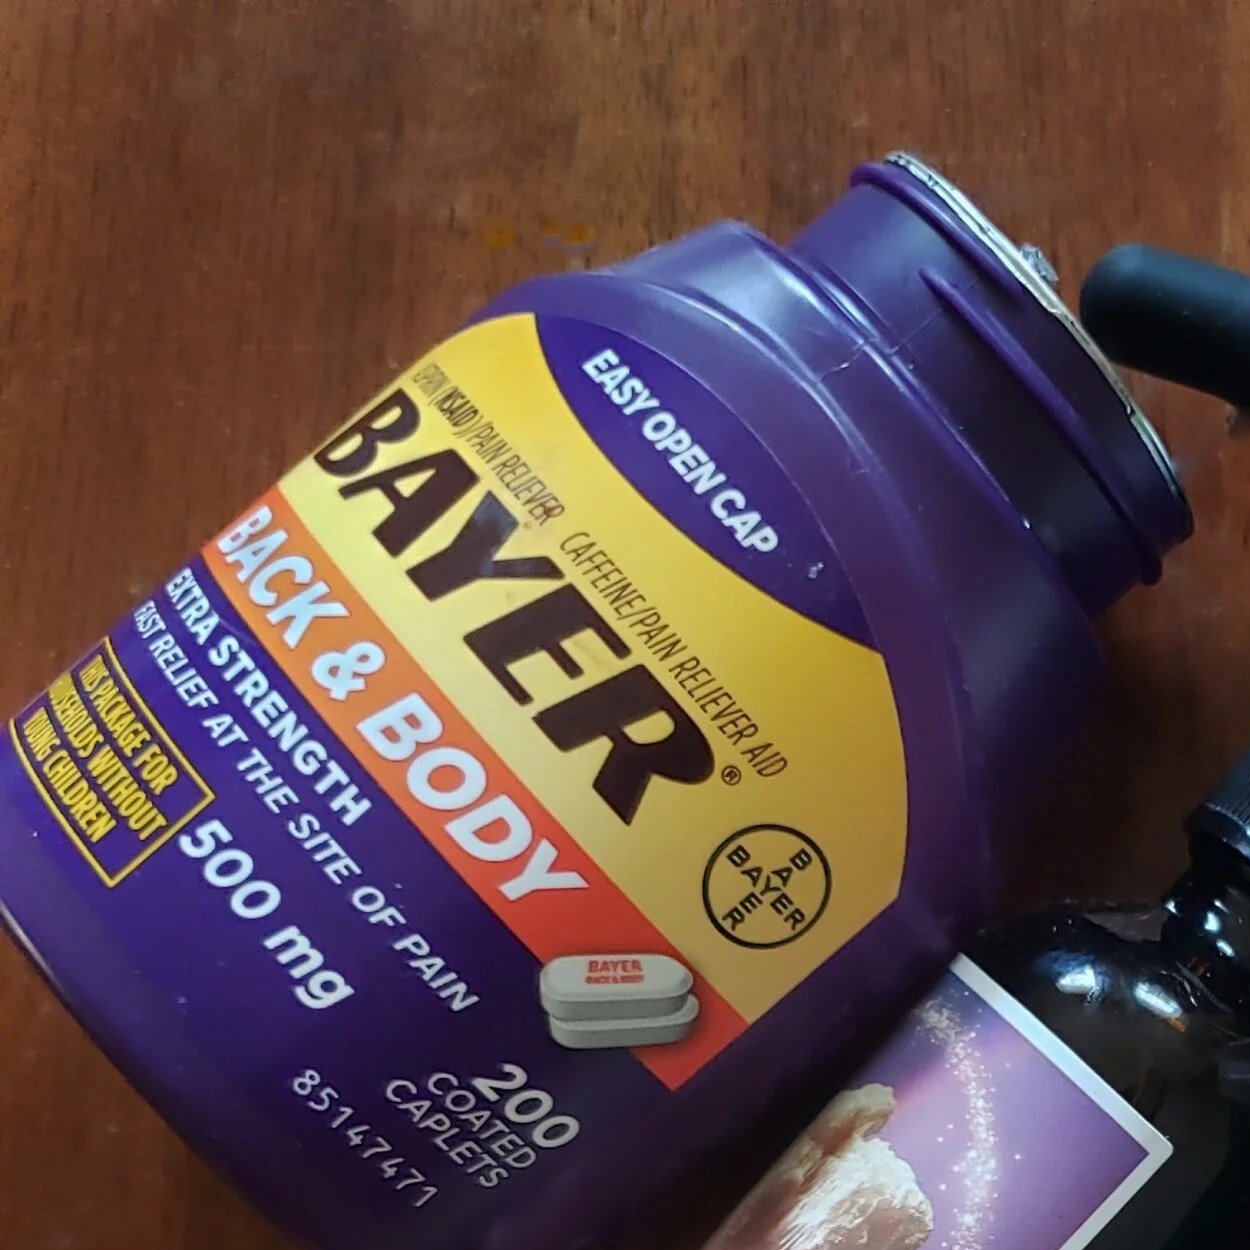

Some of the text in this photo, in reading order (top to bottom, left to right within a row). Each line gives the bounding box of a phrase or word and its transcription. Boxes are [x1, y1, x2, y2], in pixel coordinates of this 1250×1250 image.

[491, 453, 565, 526] RELIEVER
[582, 348, 779, 553] EASY OPEN CAP
[314, 387, 714, 827] BAYER
[560, 531, 788, 778] CAFFEINE/PAIN RELIEVER AID
[48, 672, 168, 841] SEHOLDS WITHOUT
[89, 677, 152, 758] PACKAGE
[133, 743, 178, 795] FOR
[165, 567, 372, 826] EXTRA STRENGTH
[216, 505, 590, 901] BACK & BODY
[42, 749, 117, 843] CHILDREN
[133, 599, 479, 1012] FAST RELIEF AT THE SITE OF PAIN
[178, 819, 355, 1009] 500 mg
[726, 844, 806, 931] BAYER
[587, 959, 644, 974] BAYER
[292, 1069, 439, 1207] 85147471
[384, 1079, 509, 1188] CAPLETS
[427, 1072, 536, 1168] COATED
[471, 1063, 580, 1148] 200
